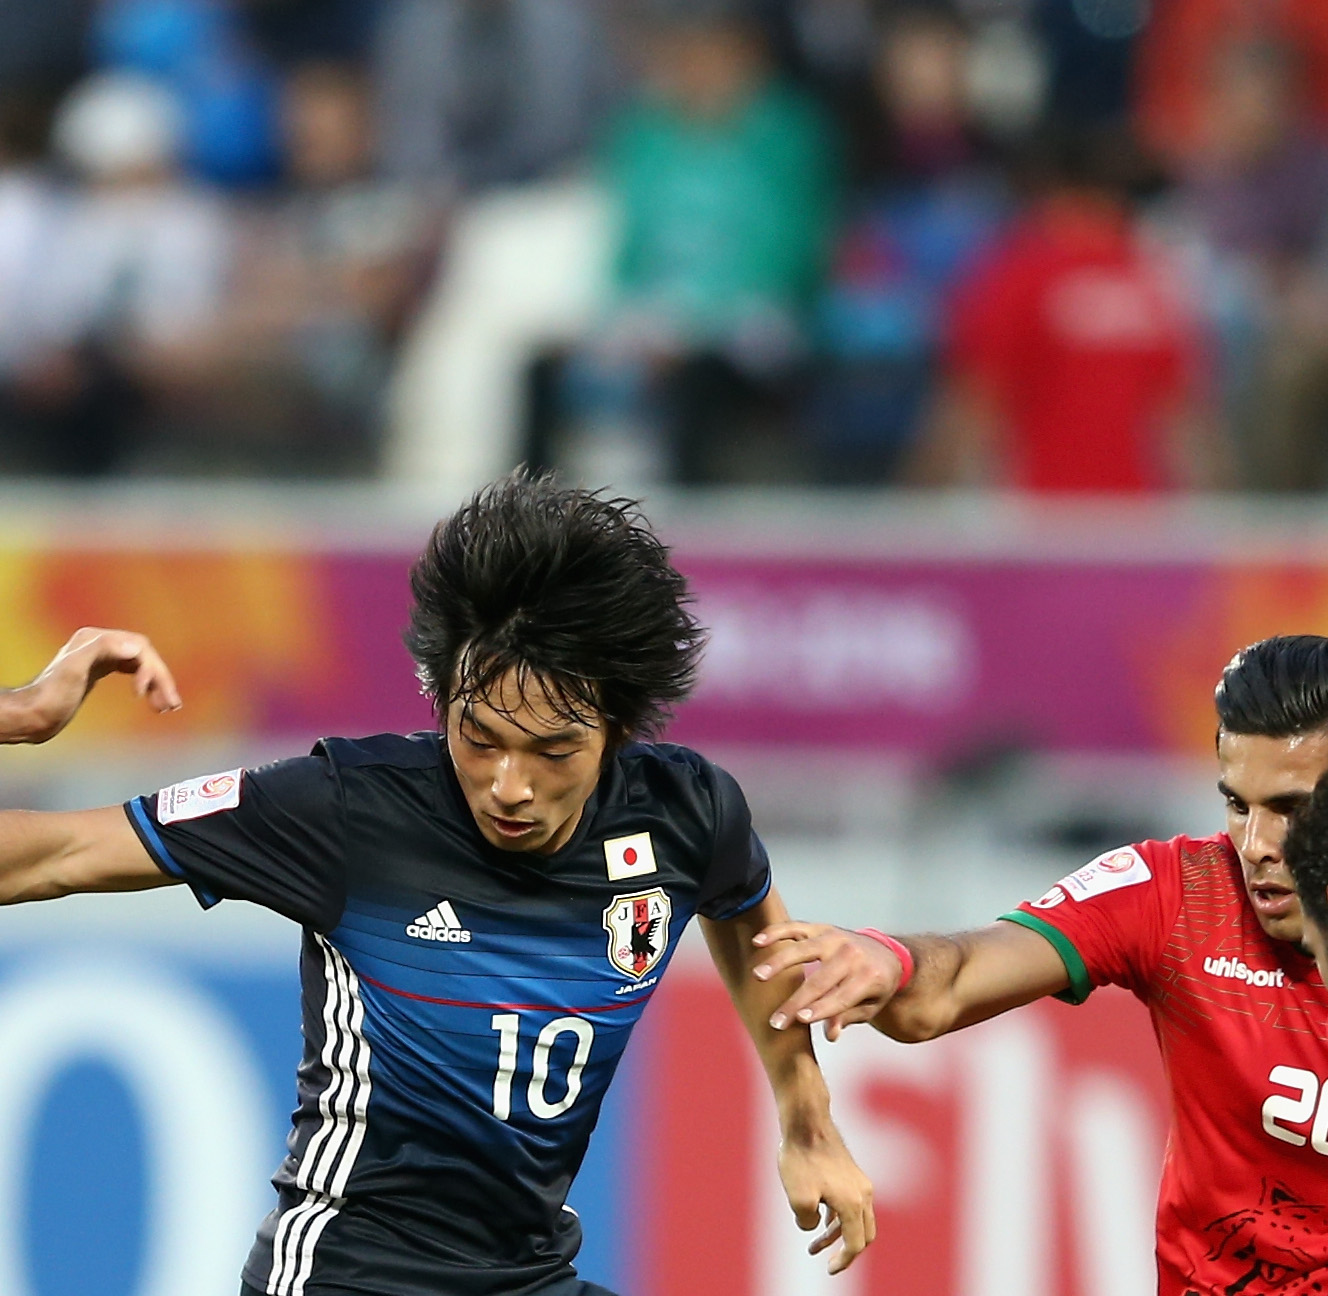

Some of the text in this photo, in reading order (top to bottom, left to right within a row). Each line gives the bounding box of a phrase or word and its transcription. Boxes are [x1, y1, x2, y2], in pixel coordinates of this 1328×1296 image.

[618, 901, 662, 921] JFA
[406, 924, 471, 943] adidas
[615, 976, 658, 995] JAPAN
[491, 1013, 595, 1121] 10
